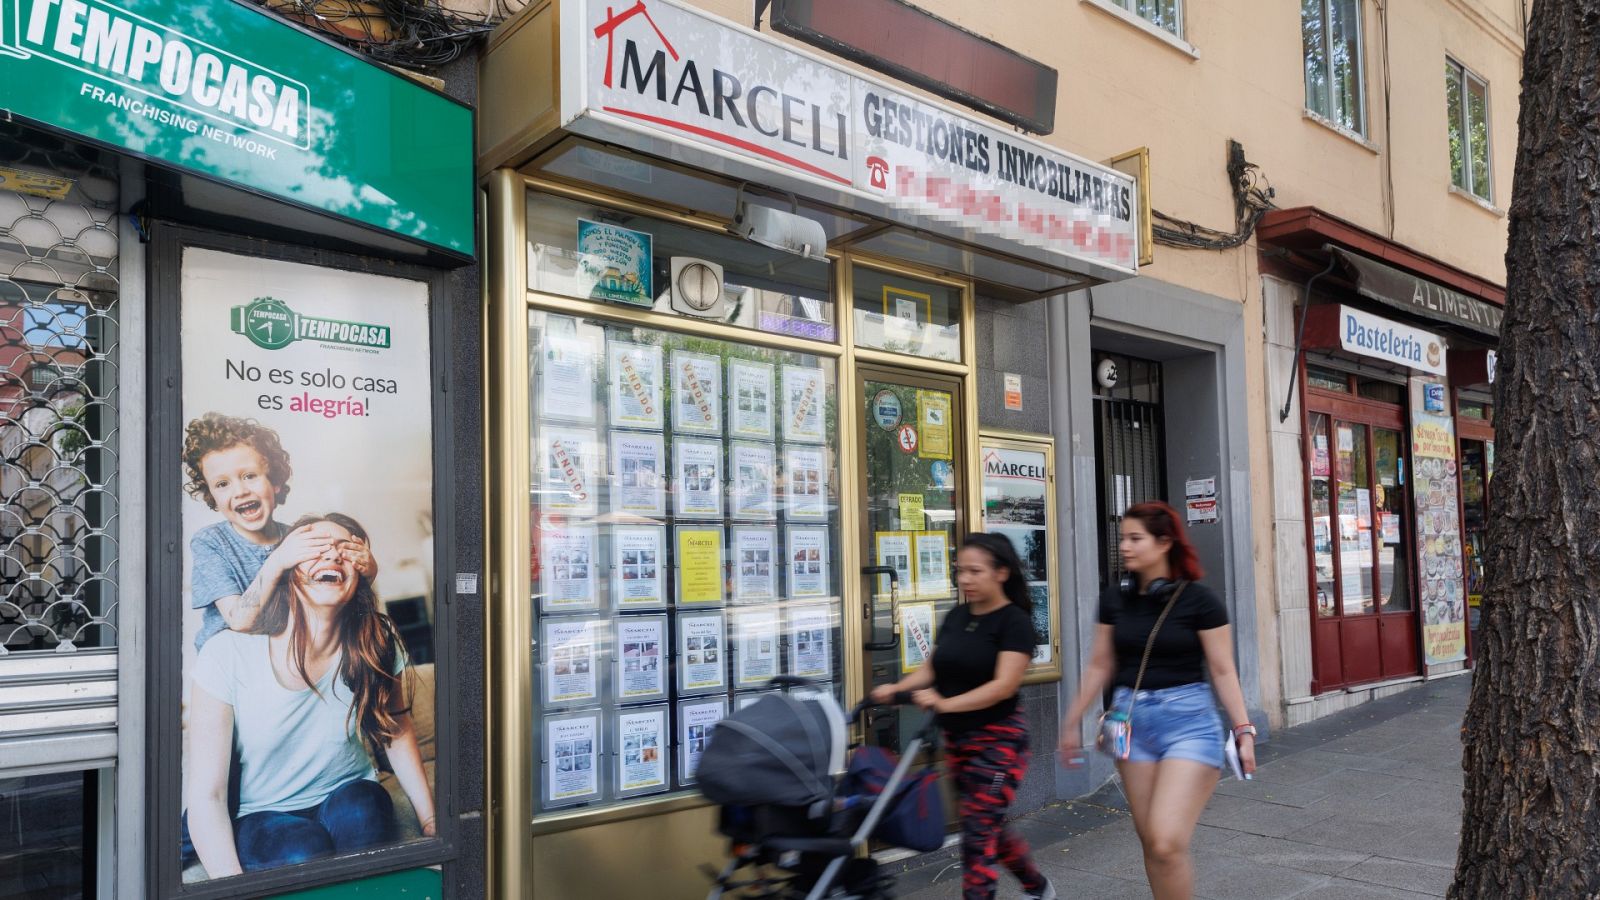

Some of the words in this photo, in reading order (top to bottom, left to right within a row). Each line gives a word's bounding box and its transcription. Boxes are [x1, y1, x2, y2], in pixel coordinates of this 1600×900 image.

[27, 0, 299, 139] TEMPOCASA
[80, 82, 198, 134] FRANCHISING
[201, 124, 277, 161] NETWORK
[620, 39, 848, 160] MARCELI
[864, 92, 990, 174] GESTIONES
[997, 141, 1131, 222] INMOBILIARIAS
[253, 309, 287, 321] TEMPOCASA
[301, 318, 387, 346] TEMPOCASA
[226, 359, 261, 382] No
[268, 367, 293, 384] es
[300, 368, 346, 389] solo
[352, 377, 397, 394] casa
[621, 355, 653, 415] VENDIDO
[682, 363, 712, 422] VENDIDO
[257, 394, 283, 410] es
[289, 391, 369, 419] alegría!
[793, 379, 816, 429] VENDIDO
[552, 440, 587, 501] VENDIDO
[987, 461, 1045, 479] MARCELI
[907, 612, 930, 659] VENDIDO
